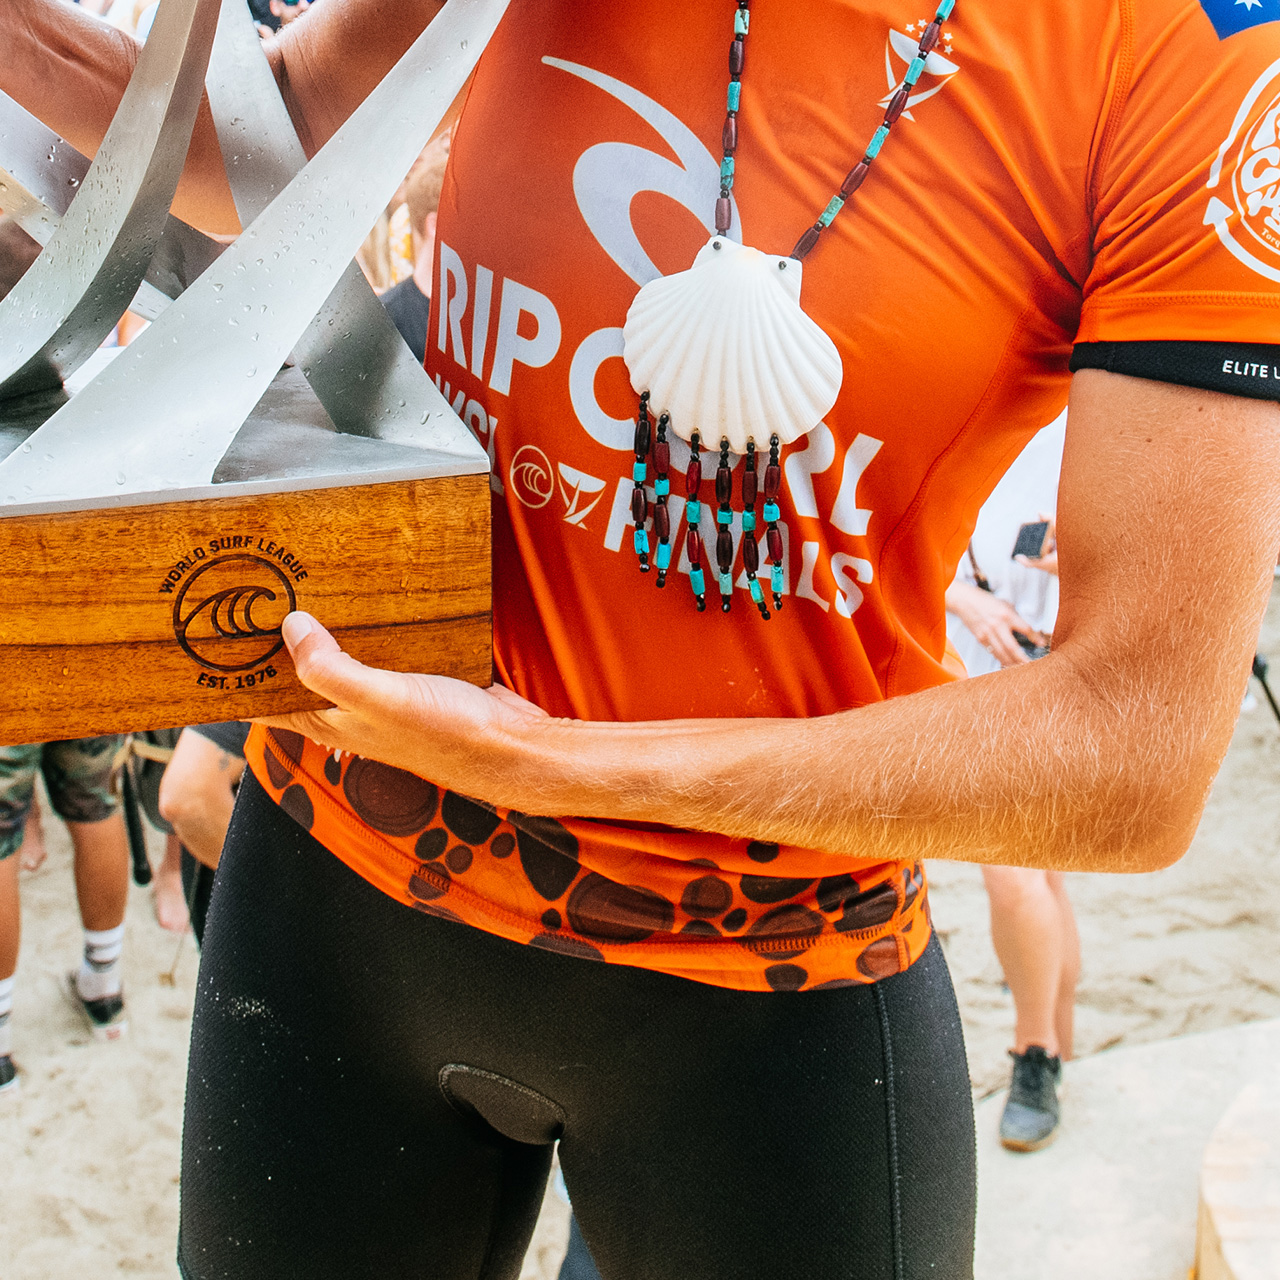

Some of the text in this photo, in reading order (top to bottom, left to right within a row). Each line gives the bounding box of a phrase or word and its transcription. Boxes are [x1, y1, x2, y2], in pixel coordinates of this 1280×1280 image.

[437, 240, 562, 397] RIP
[1222, 359, 1269, 378] ELITE
[158, 535, 309, 594] WORLD SURF LEAGUE
[196, 665, 278, 690] EST. 1976
